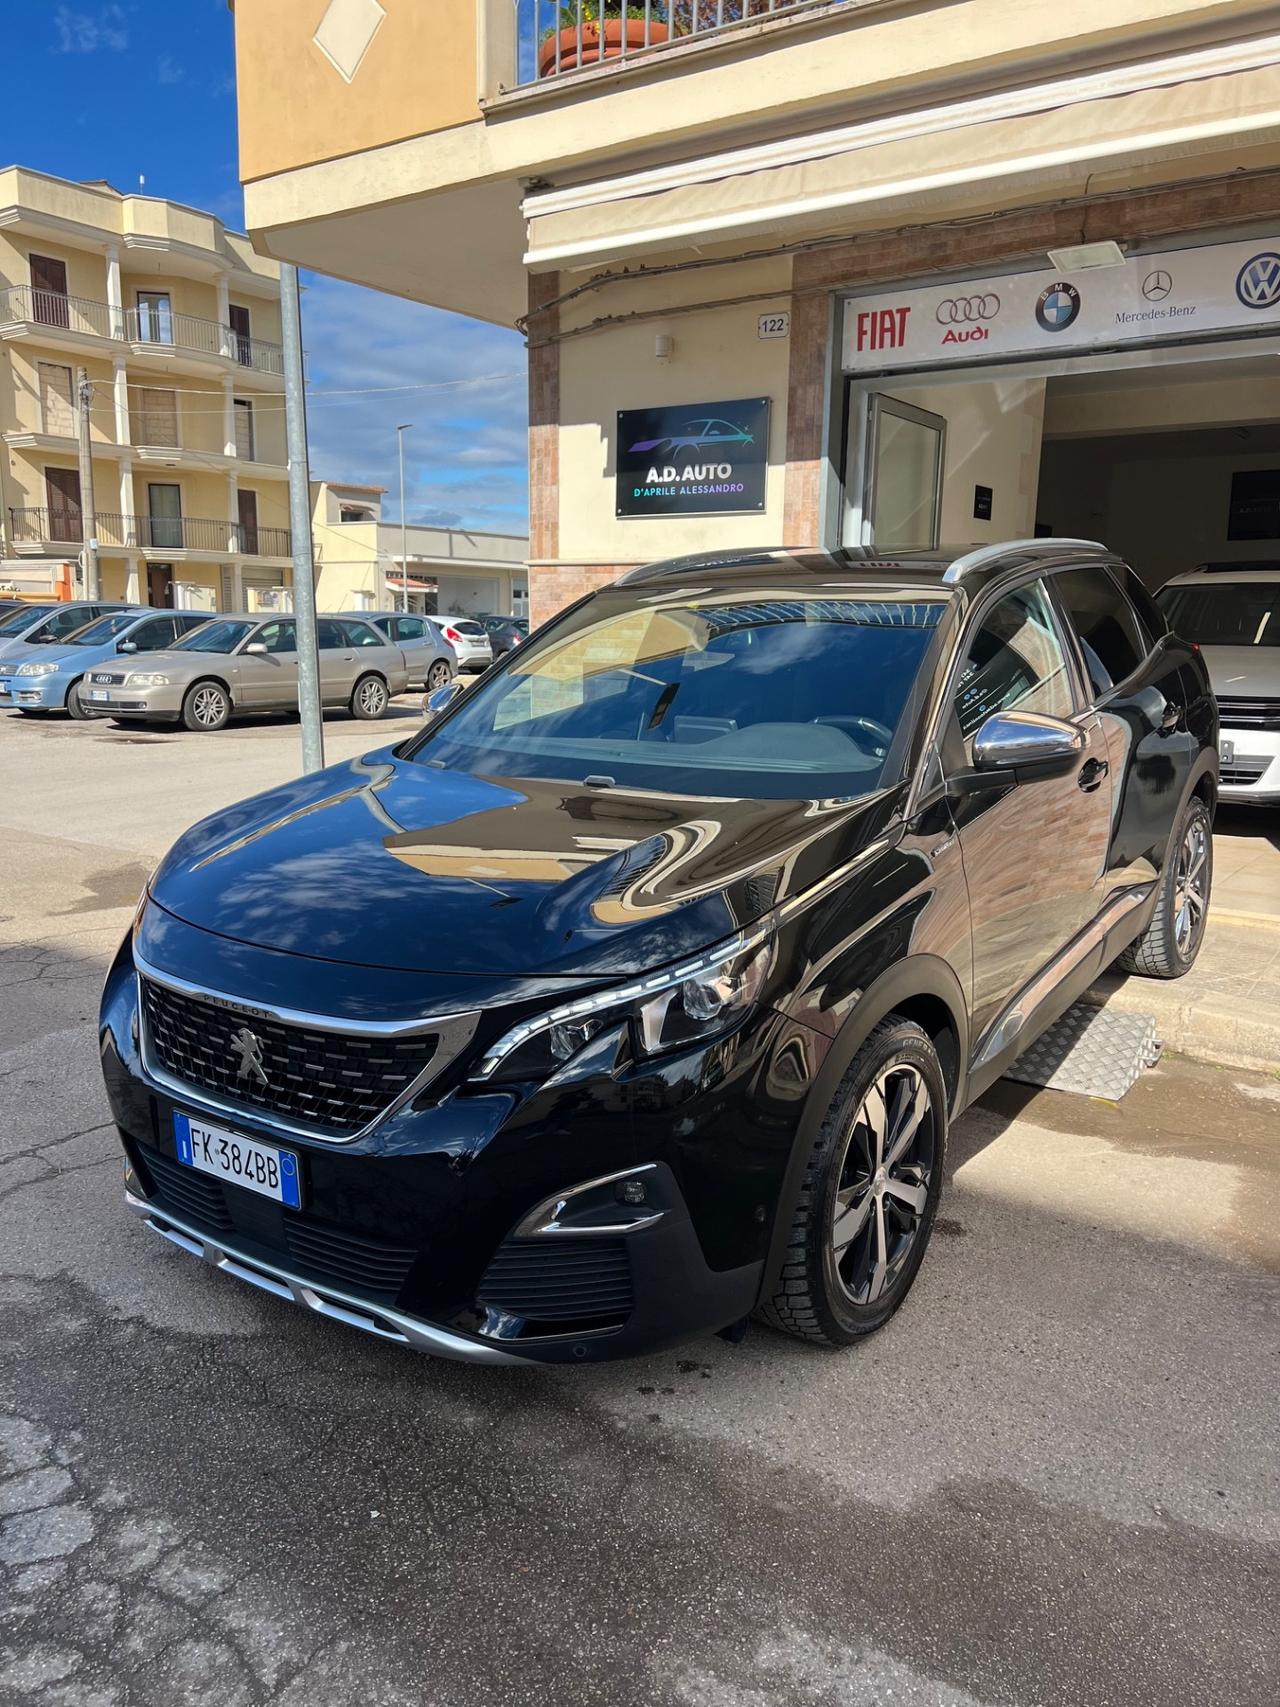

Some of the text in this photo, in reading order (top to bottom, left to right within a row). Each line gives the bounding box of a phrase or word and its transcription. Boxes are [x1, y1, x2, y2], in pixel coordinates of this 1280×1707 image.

[1115, 305, 1196, 324] Mercedes-Benz
[761, 318, 785, 333] 122
[857, 306, 911, 352] FIAT
[941, 326, 990, 345] Audi
[634, 483, 744, 497] D'APRILE ALESSANDRO
[204, 994, 271, 1018] PEUGEOT
